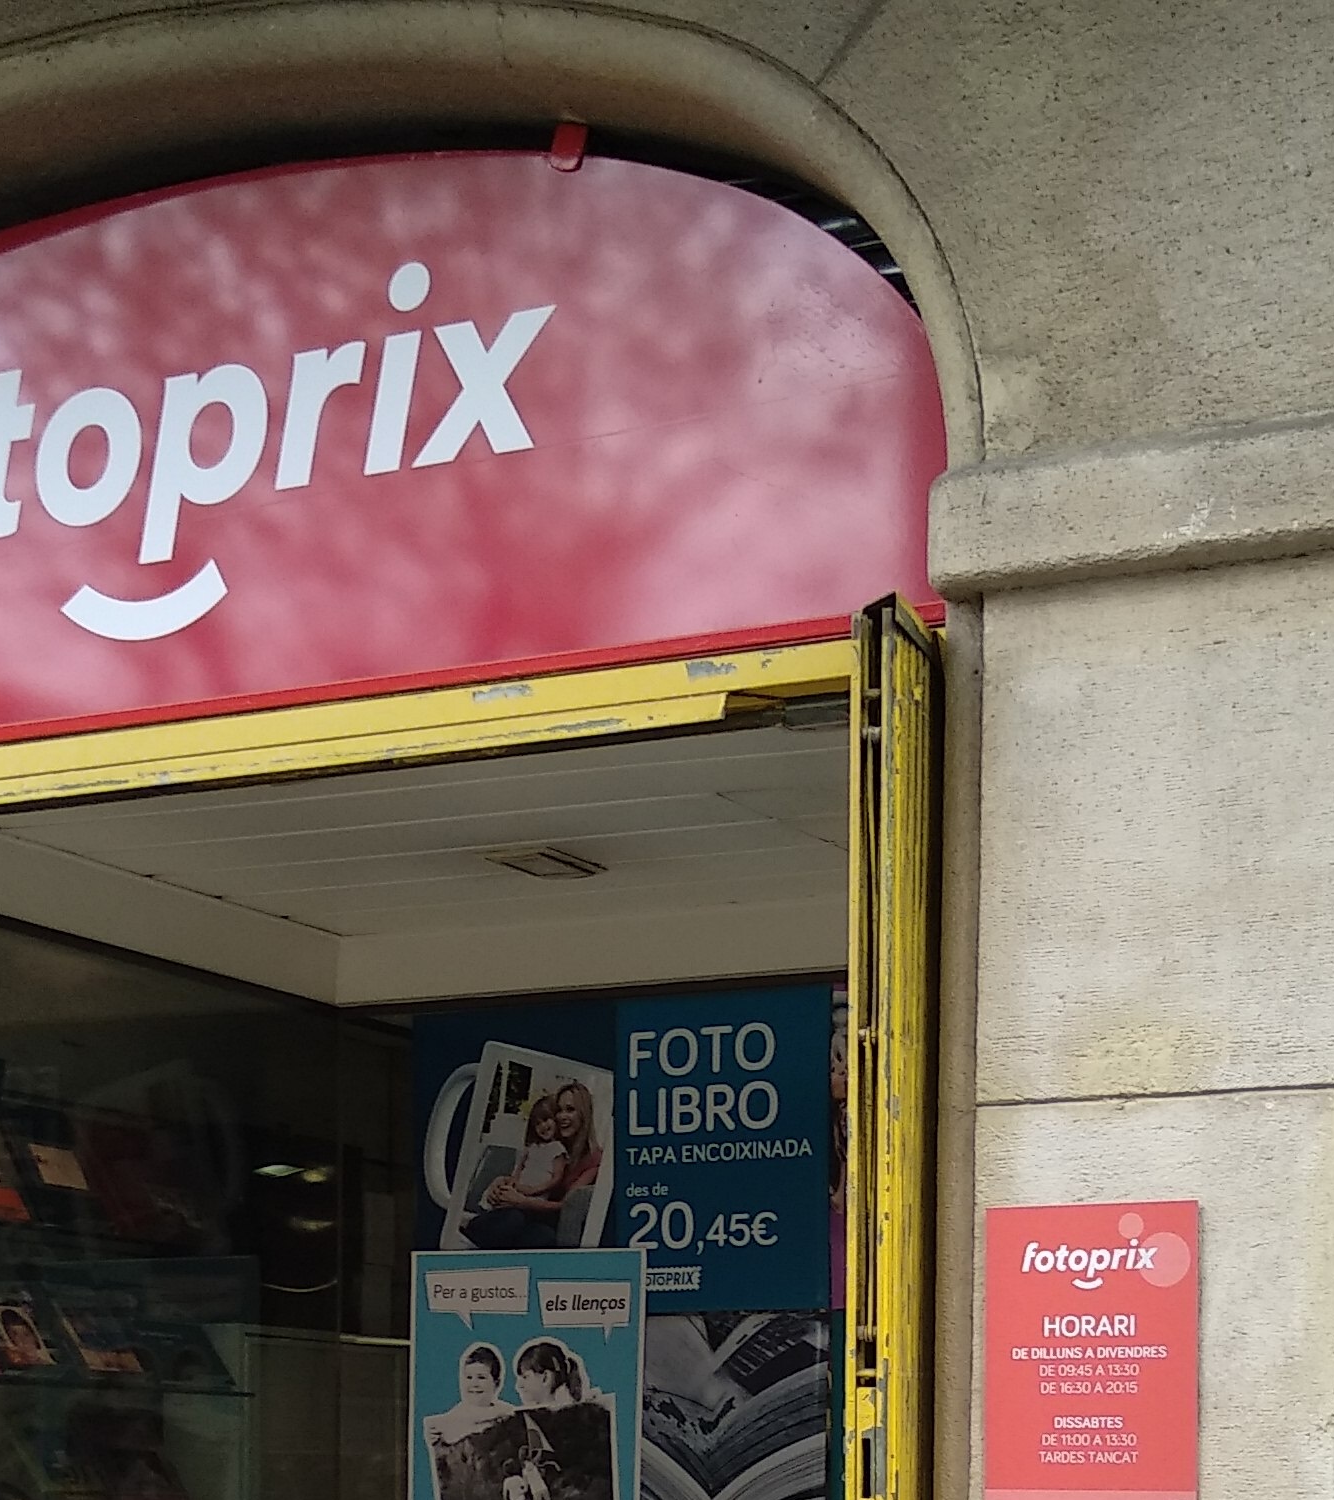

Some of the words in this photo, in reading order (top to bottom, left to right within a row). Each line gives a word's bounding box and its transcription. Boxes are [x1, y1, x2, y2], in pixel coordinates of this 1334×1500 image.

[628, 1022, 775, 1079] FOTO
[628, 1080, 779, 1136] LIBRO
[626, 1145, 677, 1166] TAPA
[681, 1138, 812, 1163] ENCOIXINADA
[626, 1184, 653, 1198] des
[655, 1182, 668, 1196] de
[628, 1200, 779, 1254] 20,45€
[1021, 1238, 1158, 1278] fotoprix
[433, 1284, 455, 1300] Per
[459, 1287, 467, 1299] a
[545, 1297, 568, 1312] els
[571, 1294, 627, 1316] llenços
[1043, 1314, 1136, 1338] HORARI
[1012, 1348, 1029, 1360] DE
[1031, 1347, 1083, 1359] DILLUNS
[1085, 1347, 1095, 1359] A
[1097, 1346, 1167, 1358] DIVENDRES
[1039, 1365, 1055, 1377] DE
[1058, 1365, 1092, 1377] 09:45
[1095, 1364, 1105, 1376] A
[1108, 1364, 1140, 1376] 13:30
[1041, 1382, 1057, 1394] DE
[1060, 1382, 1091, 1394] 16:30
[1093, 1382, 1103, 1393] A
[1106, 1382, 1138, 1394] 20:15
[1054, 1417, 1123, 1429] DISSABTES
[1042, 1434, 1058, 1446] DE
[1060, 1434, 1090, 1446] 11:00
[1092, 1434, 1102, 1446] A
[1105, 1434, 1137, 1446] 13:30
[1039, 1451, 1085, 1464] TARDES
[1088, 1451, 1138, 1464] TANCAT
